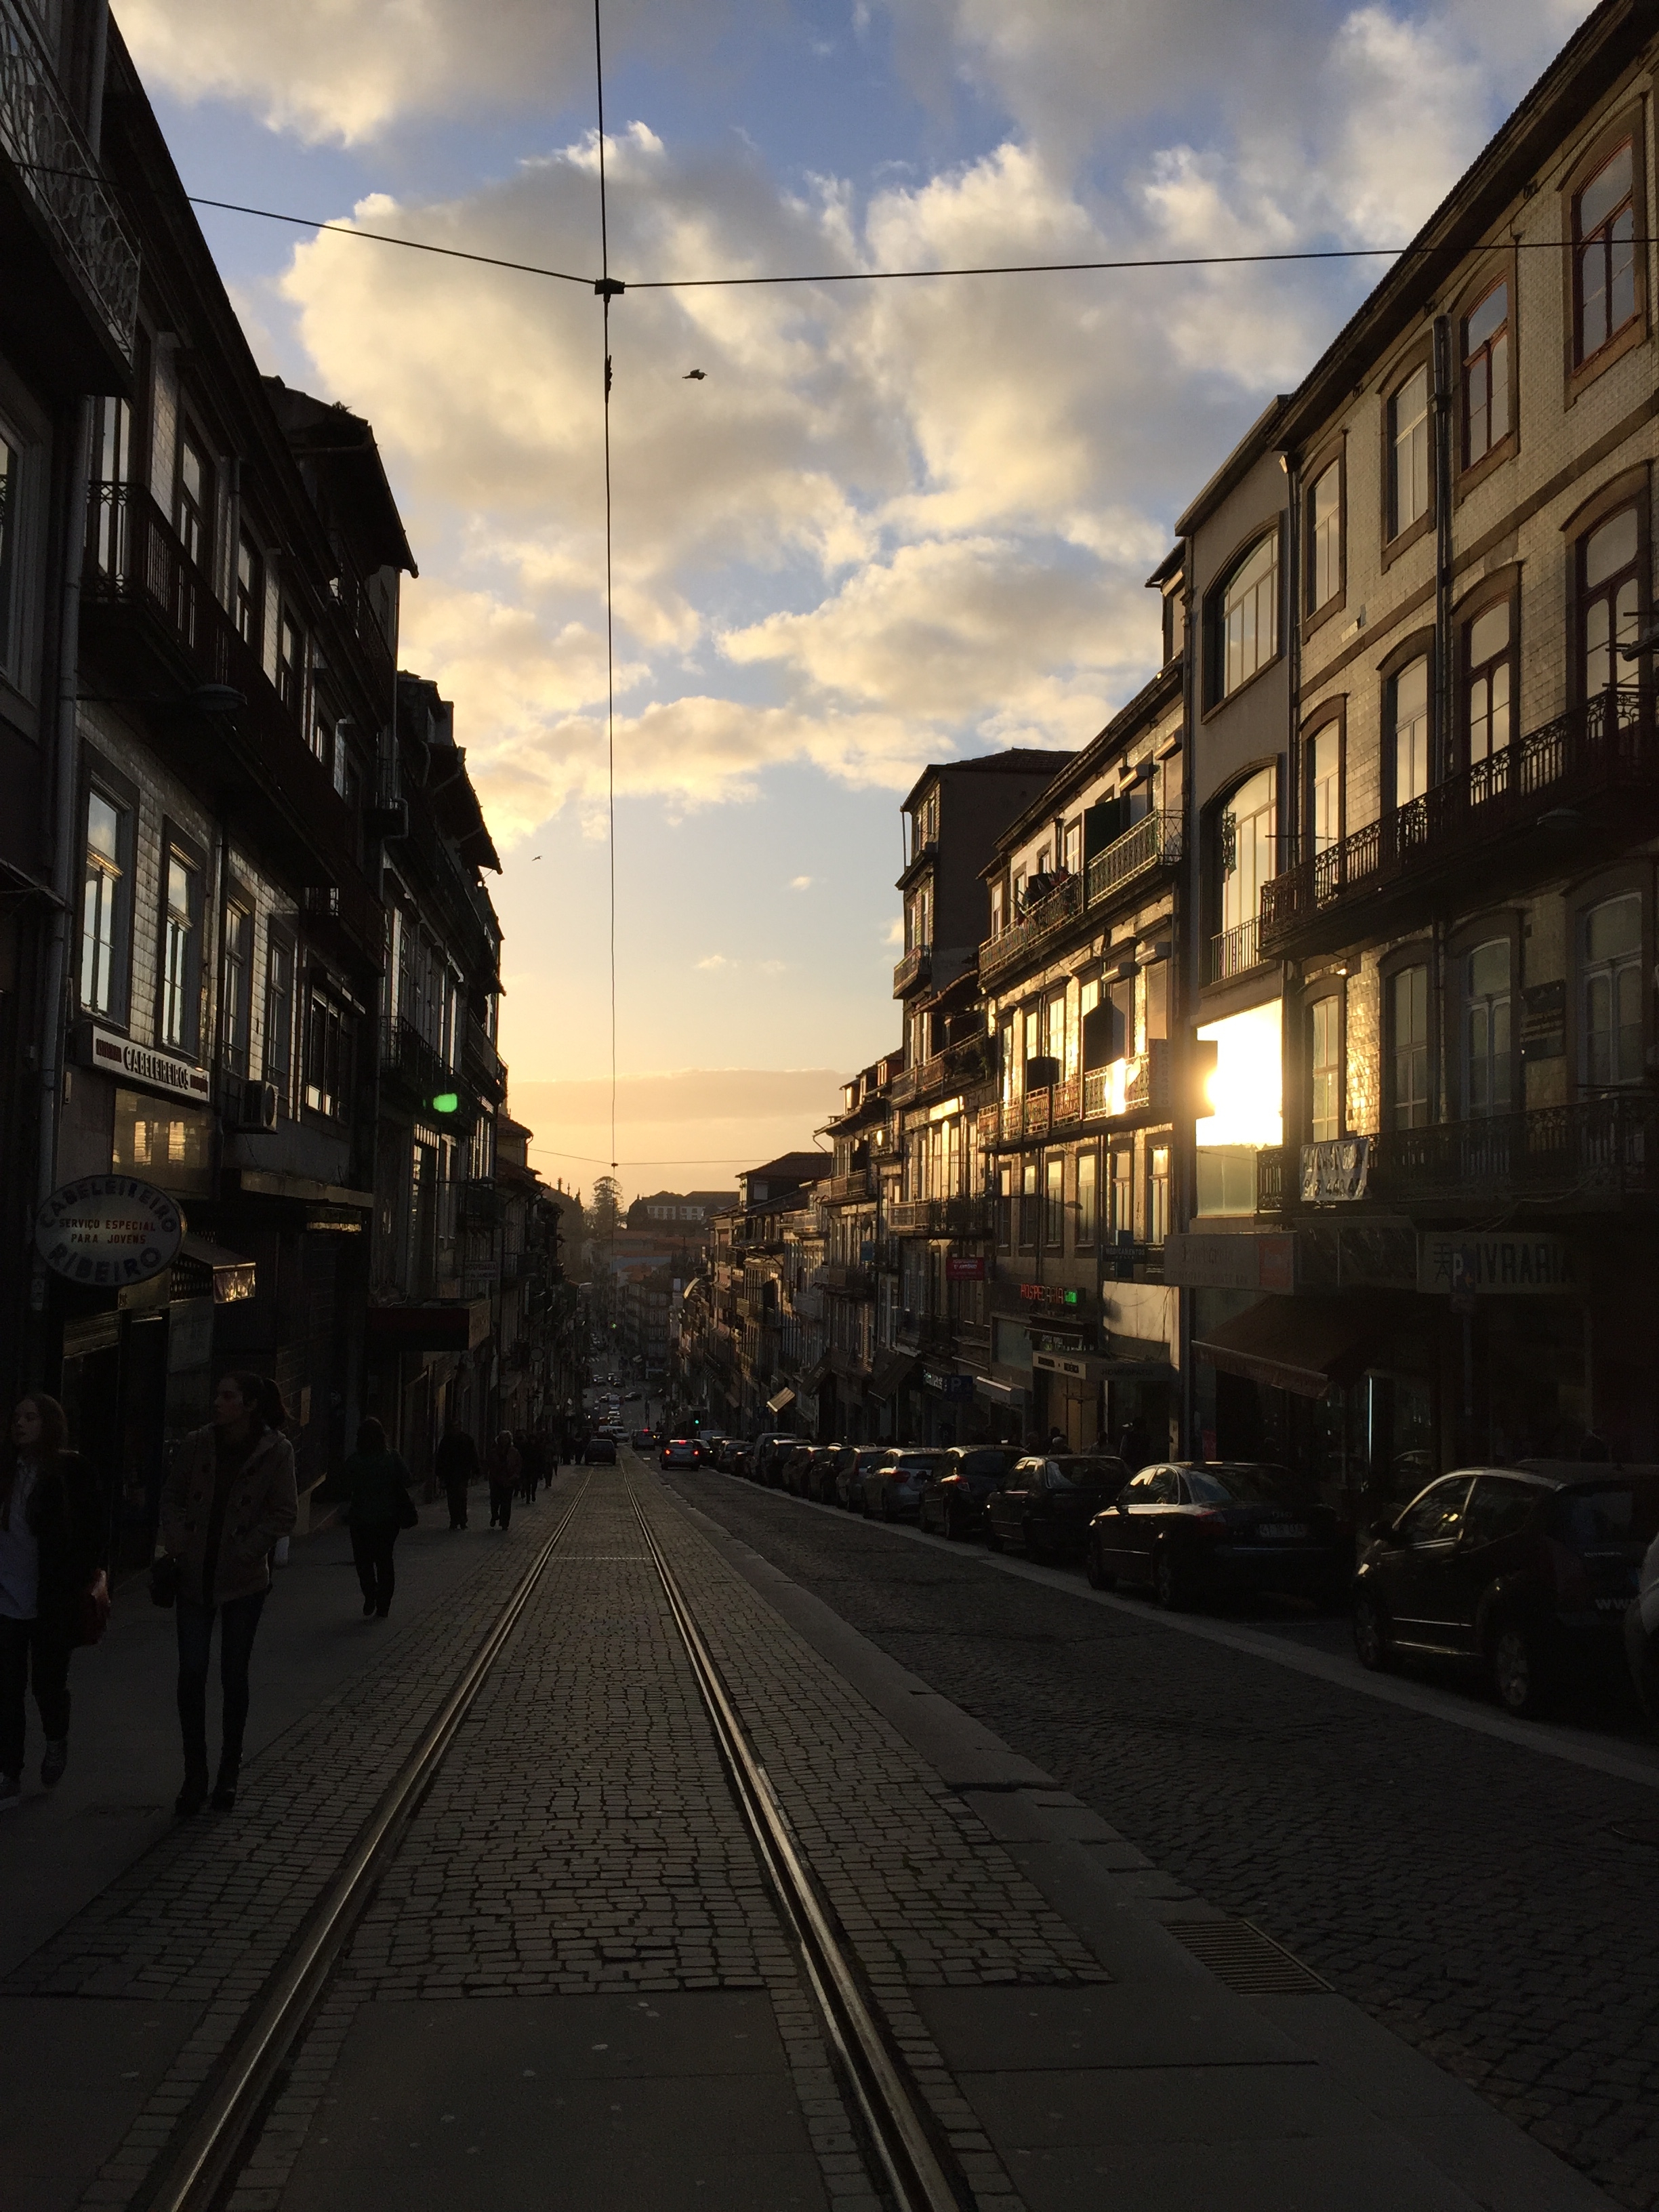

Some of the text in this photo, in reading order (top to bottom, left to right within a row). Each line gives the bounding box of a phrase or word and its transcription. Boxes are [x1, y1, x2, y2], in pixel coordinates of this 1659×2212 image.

[123, 1046, 188, 1090] CABELEIREIROS
[41, 1181, 177, 1232] CABELEIREIRO
[59, 1218, 156, 1231] SERVIÇO ESPECIAL
[70, 1233, 146, 1244] PARA JOVENS
[47, 1244, 161, 1283] RIBEIRO
[1452, 1252, 1464, 1286] P
[1461, 1242, 1574, 1284] IVRARIA
[1021, 1283, 1064, 1305] HOSPEDARIA
[951, 1377, 962, 1392] P
